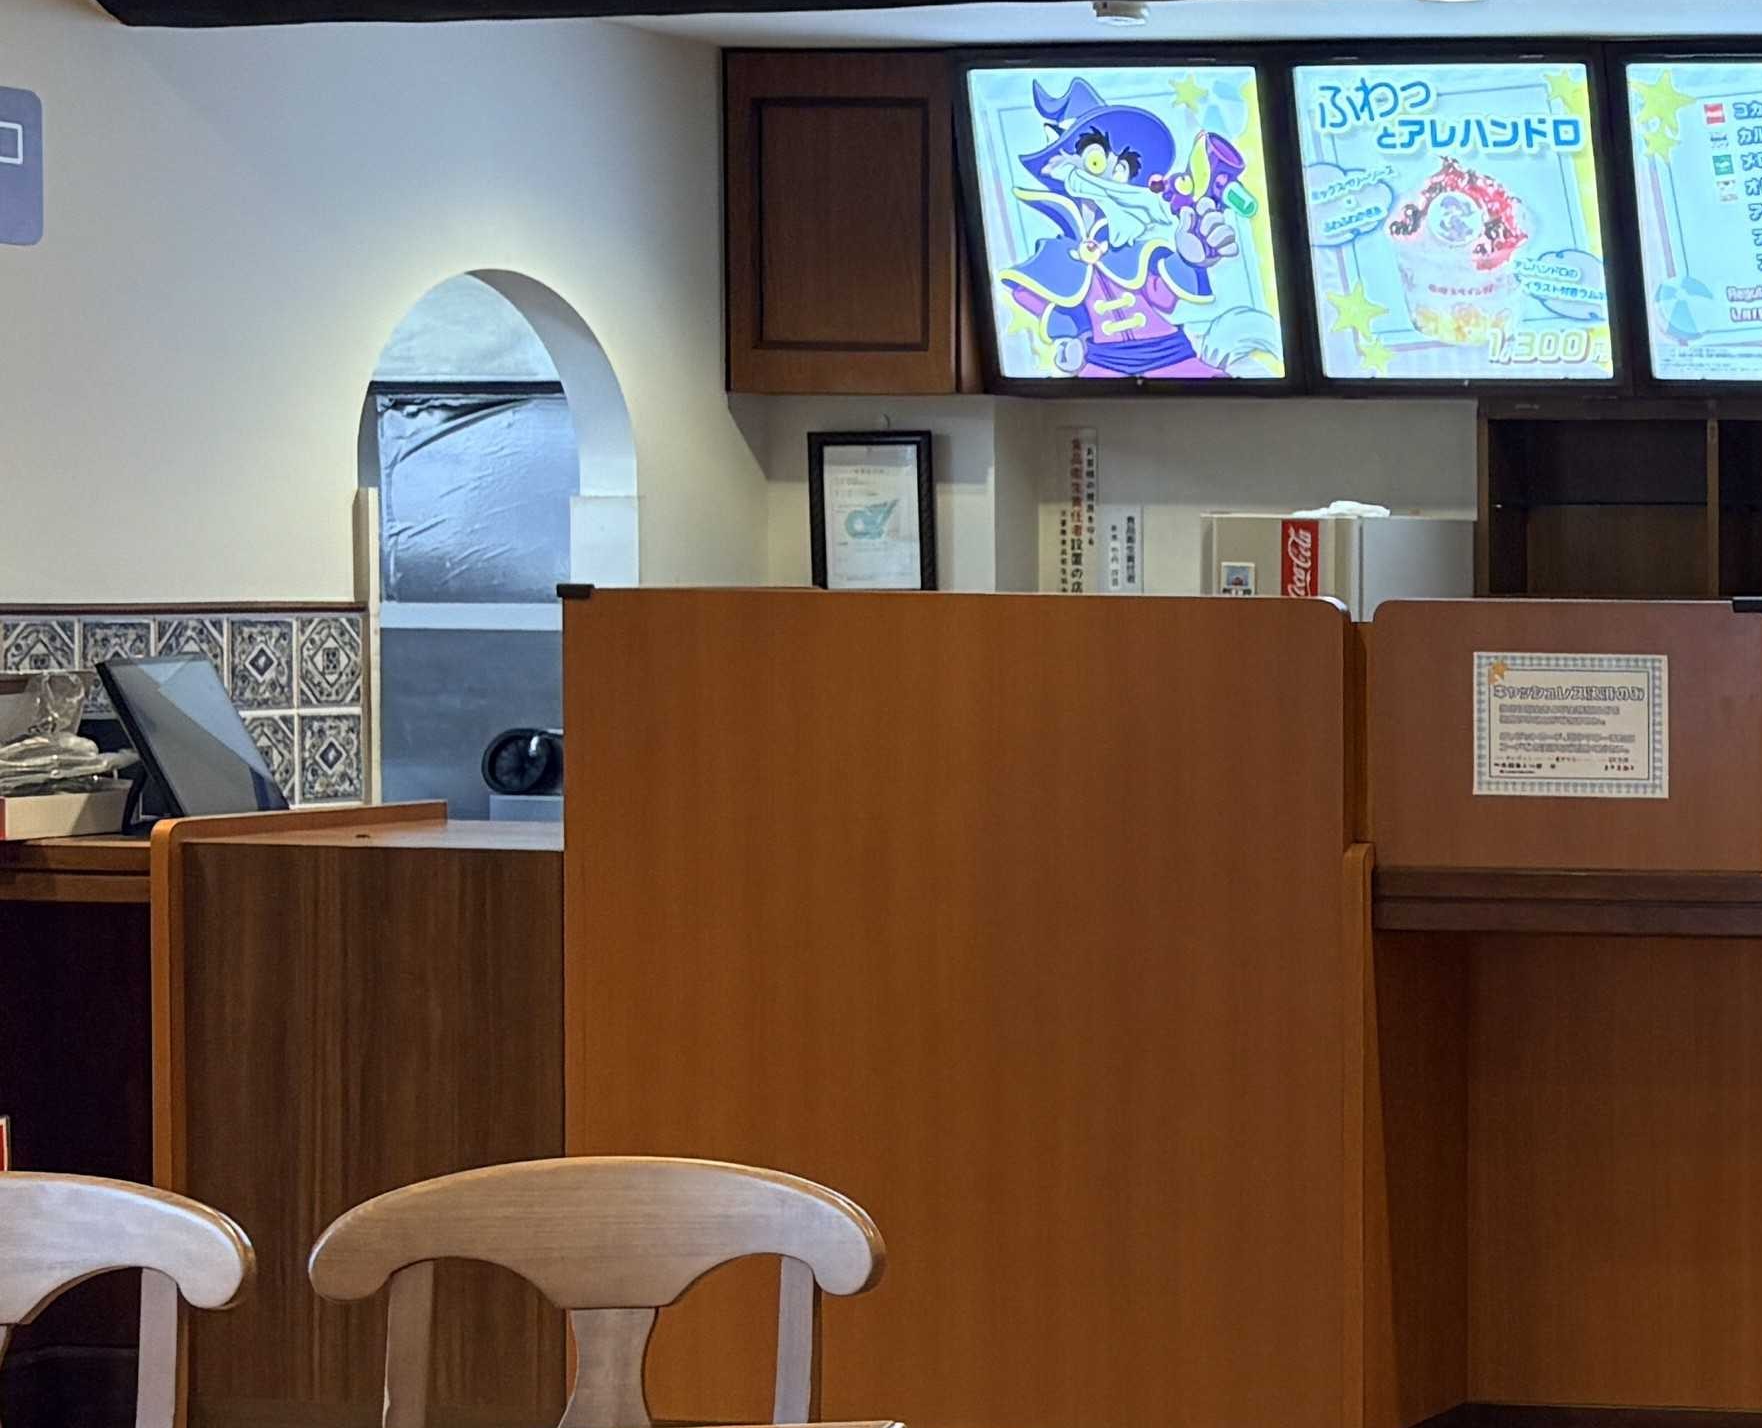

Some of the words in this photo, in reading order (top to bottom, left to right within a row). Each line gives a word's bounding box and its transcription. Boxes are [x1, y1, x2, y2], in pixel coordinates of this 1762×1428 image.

[1317, 77, 1431, 129] ふわっ
[1376, 118, 1582, 149] とアレハンドロ
